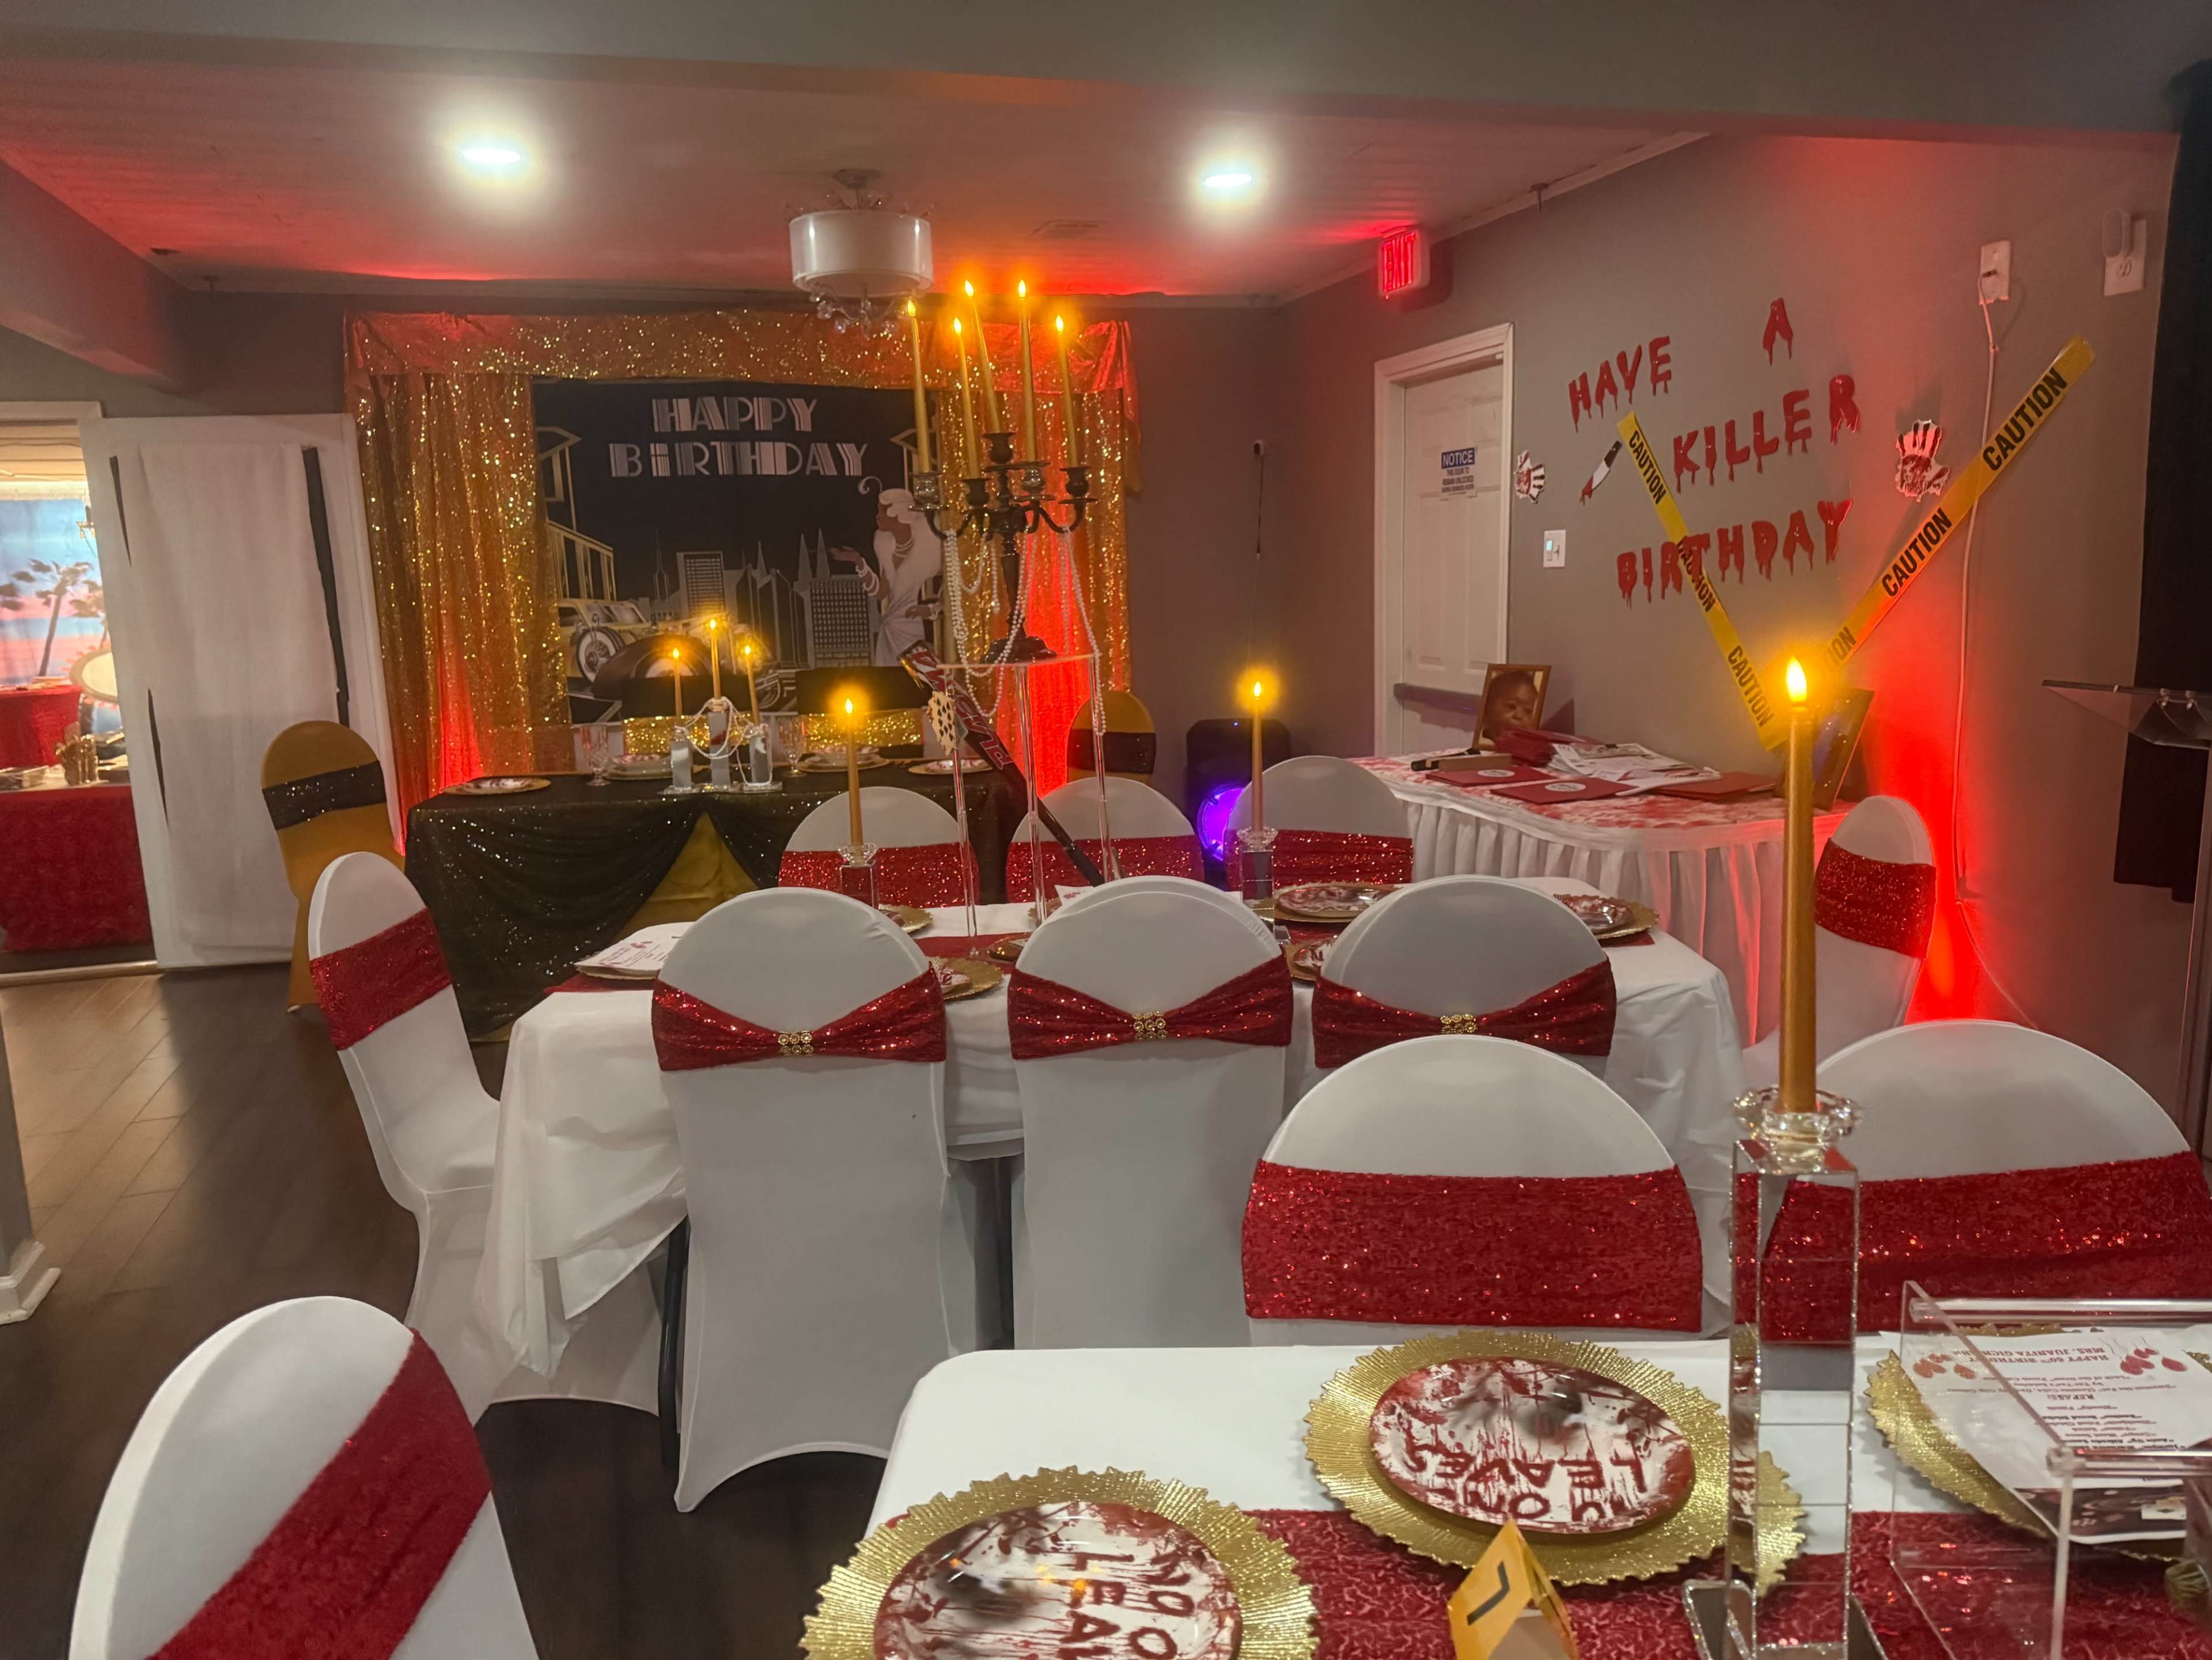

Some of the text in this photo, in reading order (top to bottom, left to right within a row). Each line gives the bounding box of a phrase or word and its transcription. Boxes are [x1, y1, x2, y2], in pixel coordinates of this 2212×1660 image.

[1383, 232, 1416, 292] EXIT
[1568, 297, 1793, 433] HAVE A
[652, 396, 818, 433] HAPPY
[1673, 374, 1861, 494] KILLER
[1982, 367, 2068, 472] CAUTION
[1442, 450, 1474, 467] NOTICE
[1628, 429, 1667, 505] CAUTION
[1616, 498, 1853, 610] BIRTHDAY
[1881, 507, 1953, 598] CAUTION
[1728, 645, 1775, 728] CAUTION
[1968, 1356, 2037, 1364] BIRTHDY
[2016, 1348, 2070, 1356] JUANITA
[2069, 1355, 2109, 1363] HAPPY
[2072, 1347, 2105, 1355] MRS.
[1404, 1433, 1647, 1493] LEAVES
